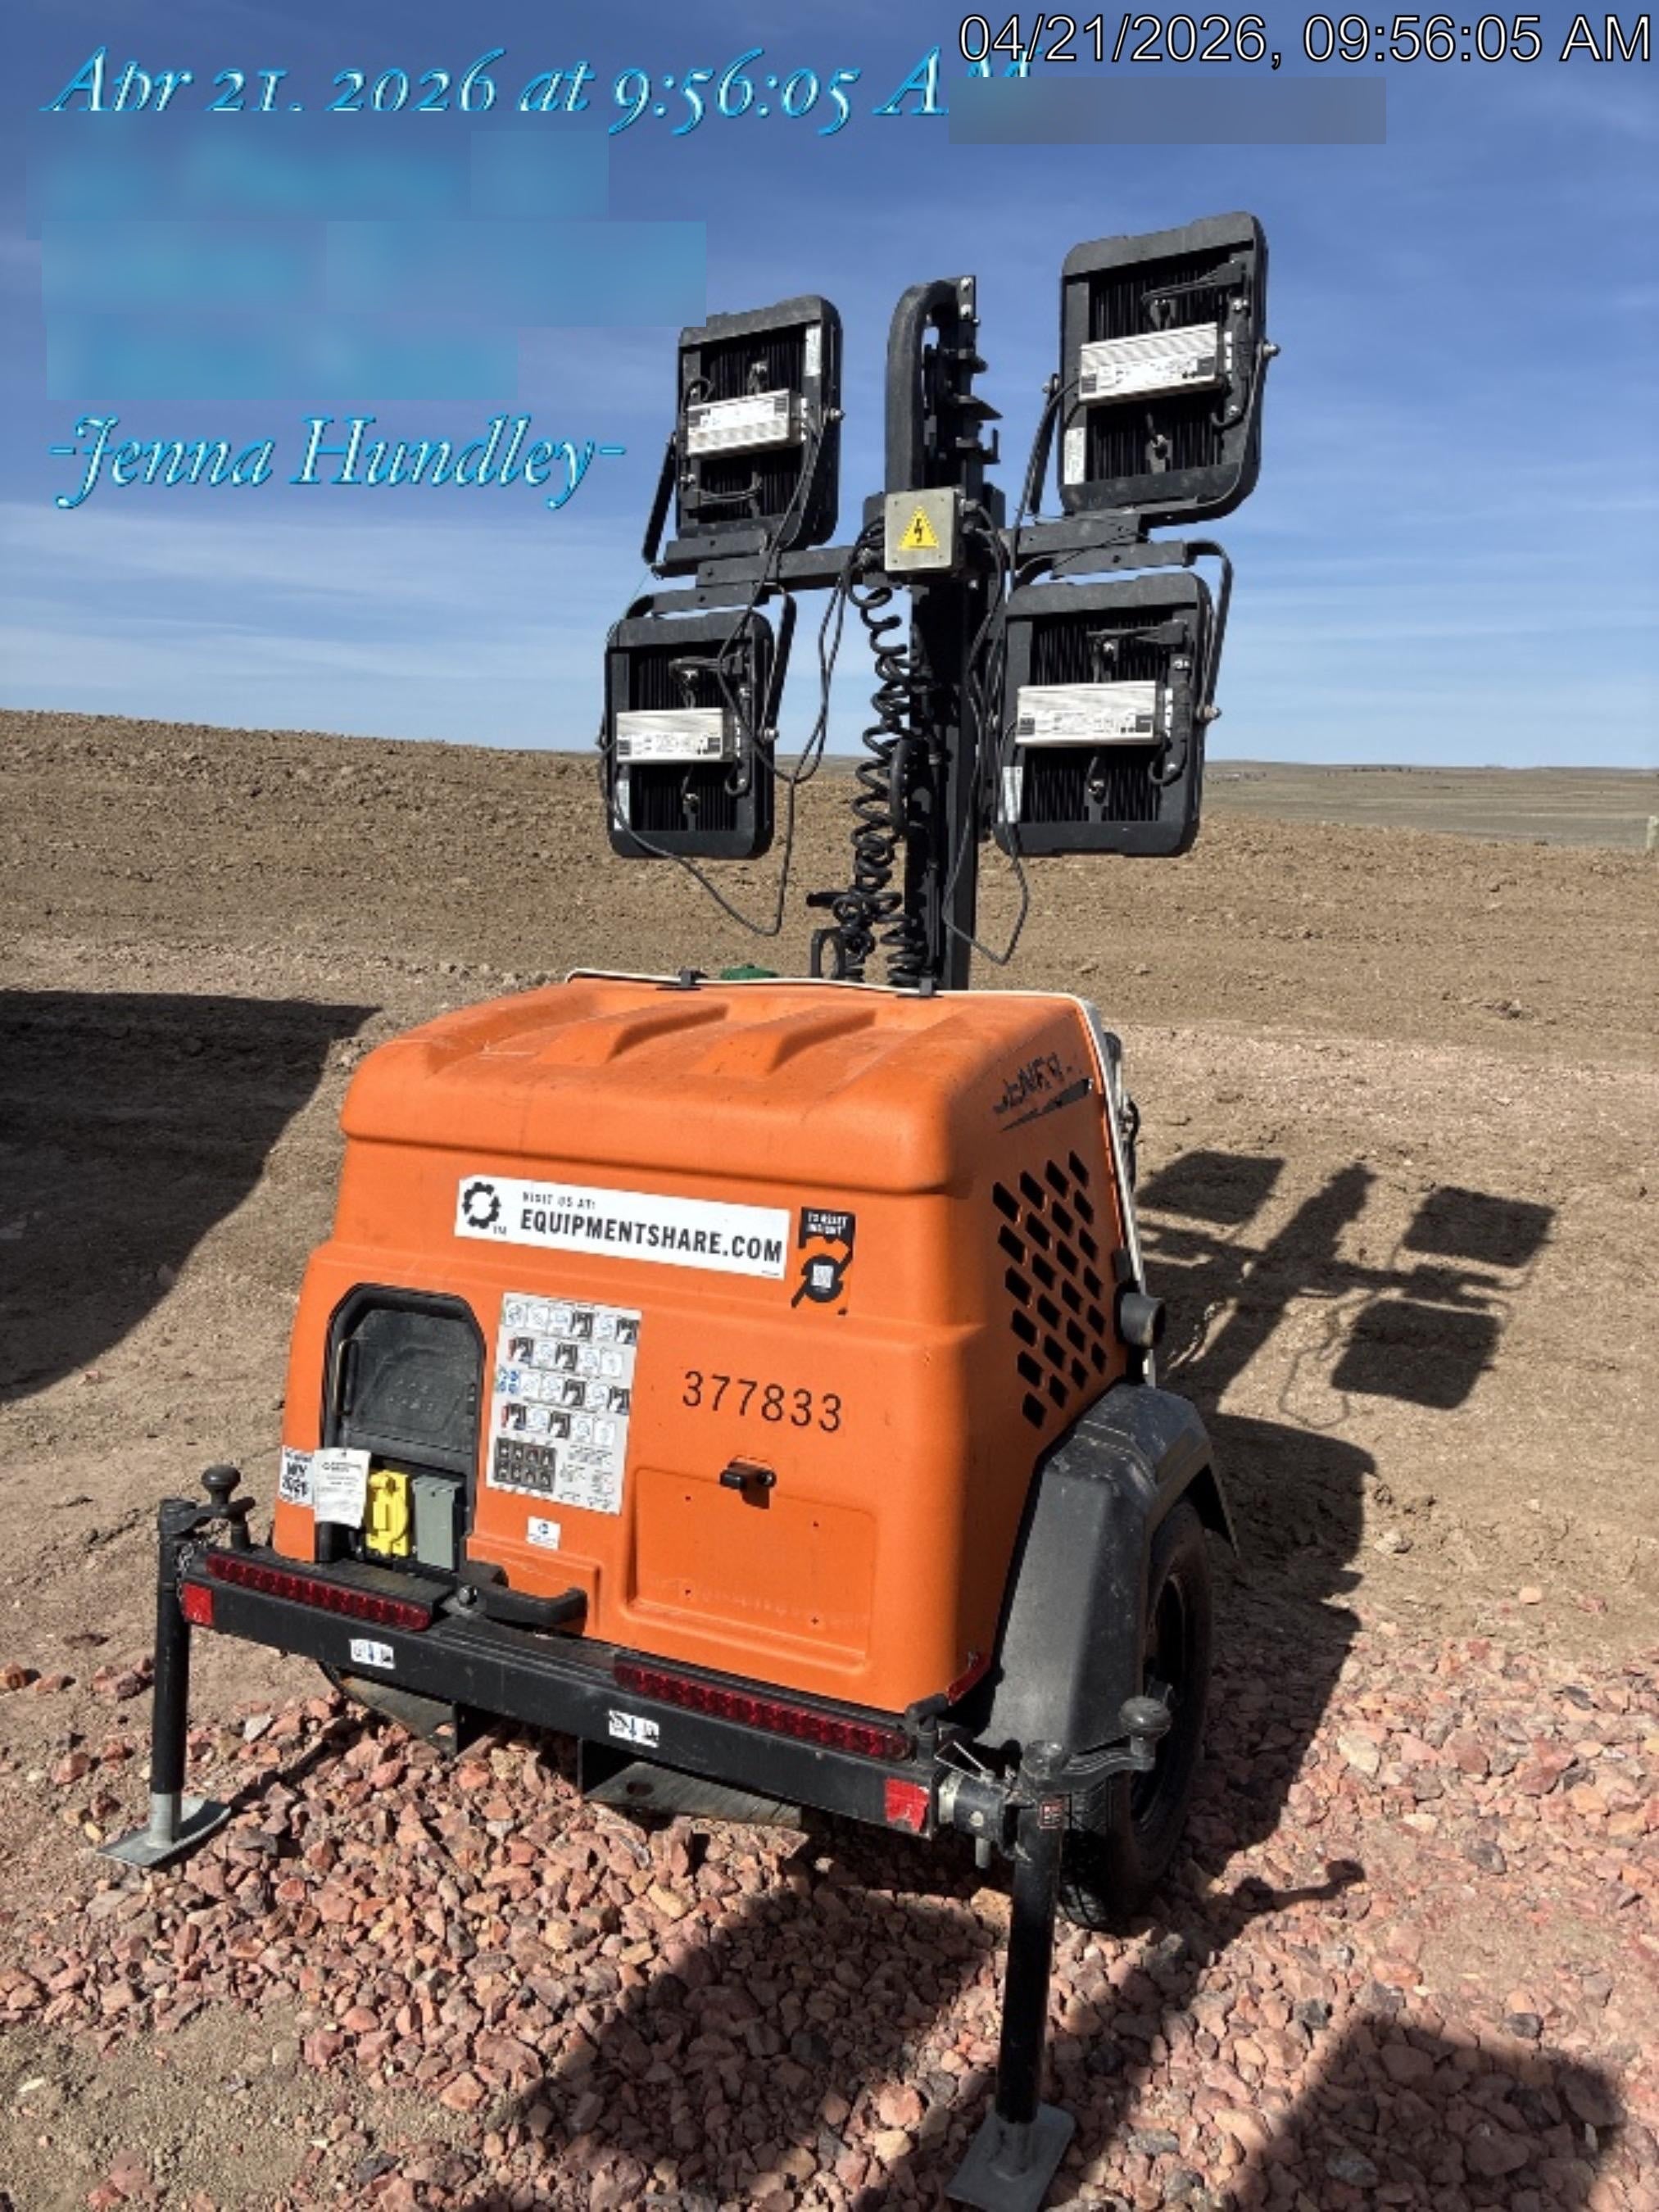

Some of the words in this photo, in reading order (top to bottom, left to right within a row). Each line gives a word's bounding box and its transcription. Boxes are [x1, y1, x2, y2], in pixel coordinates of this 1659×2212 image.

[523, 1192, 553, 1204] VISIT
[558, 1196, 573, 1208] US
[578, 1199, 596, 1209] AT:
[520, 1208, 783, 1264] EQUIPMENTSHARE.COM
[682, 1371, 841, 1433] 377833
